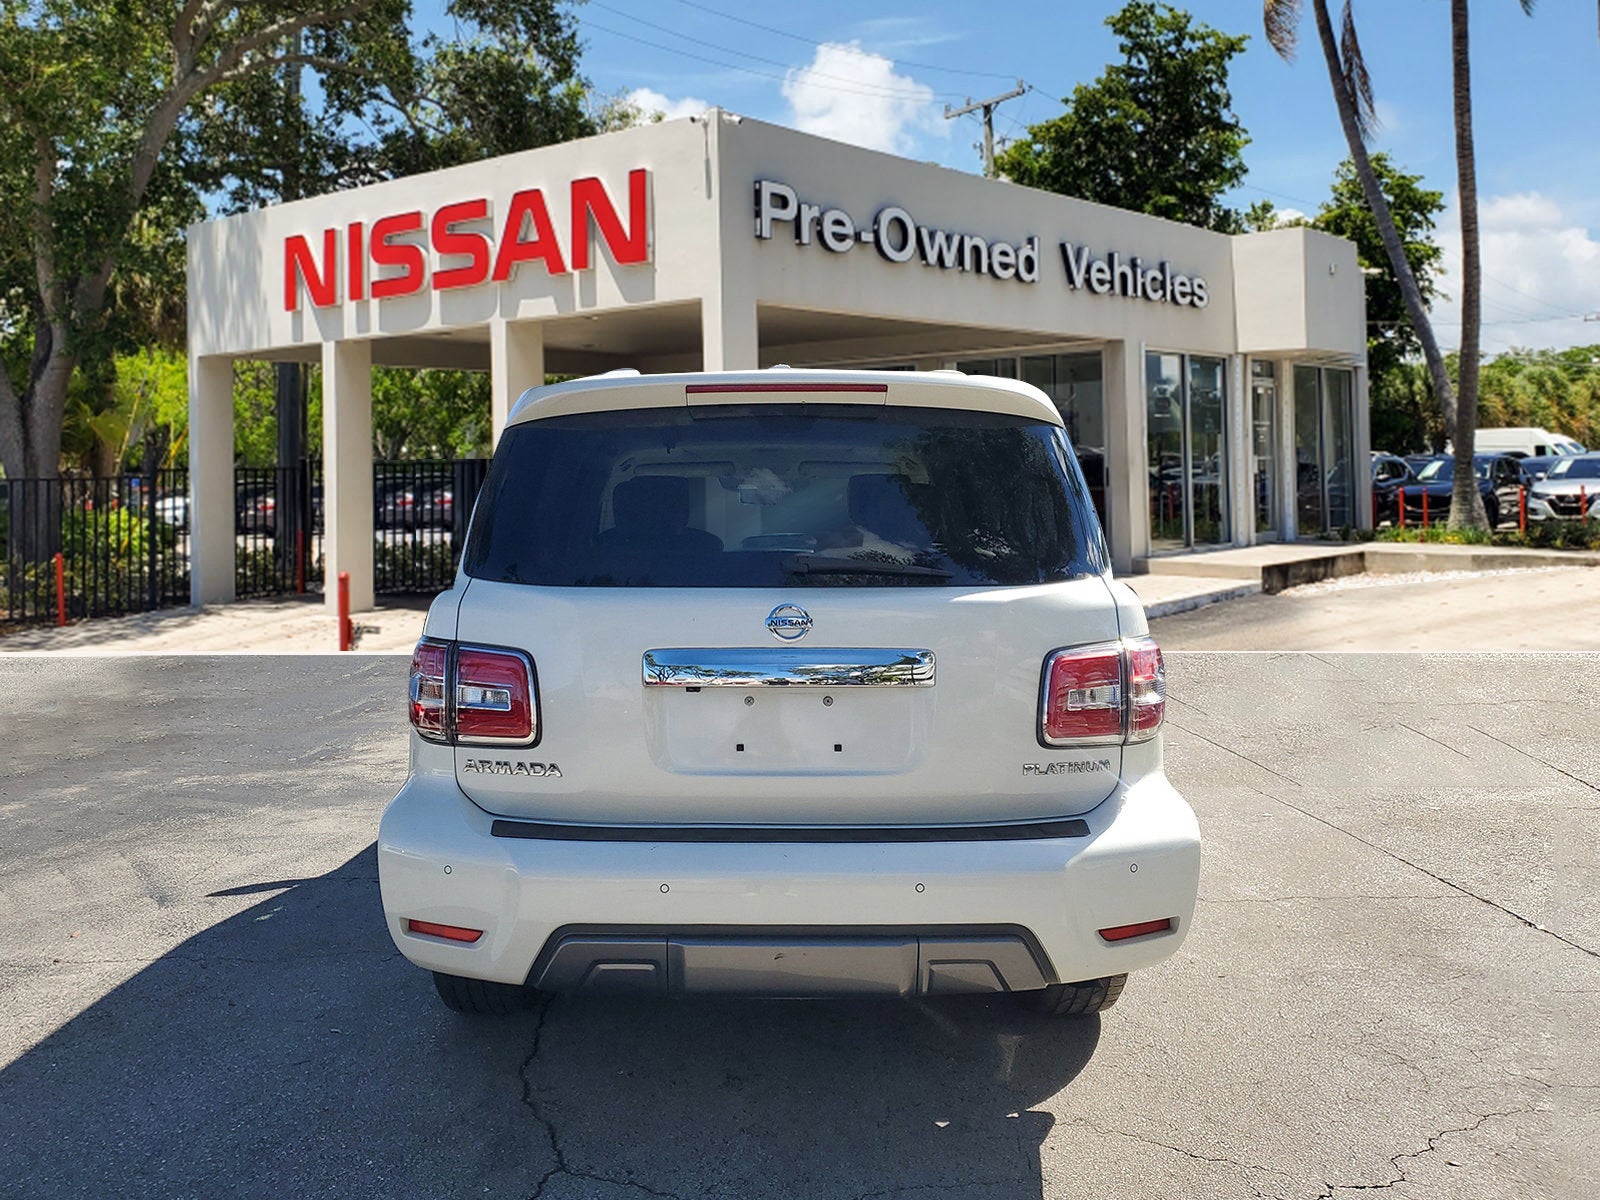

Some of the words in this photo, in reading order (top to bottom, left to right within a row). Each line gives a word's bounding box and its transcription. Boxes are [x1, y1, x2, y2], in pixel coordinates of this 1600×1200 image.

[284, 168, 648, 311] NISSAN
[754, 180, 1040, 283] Pre-Owned
[1061, 241, 1208, 308] Vehicles
[769, 619, 809, 628] NISSAN
[463, 759, 563, 778] ARMADA
[1022, 759, 1111, 776] PLATINUM
